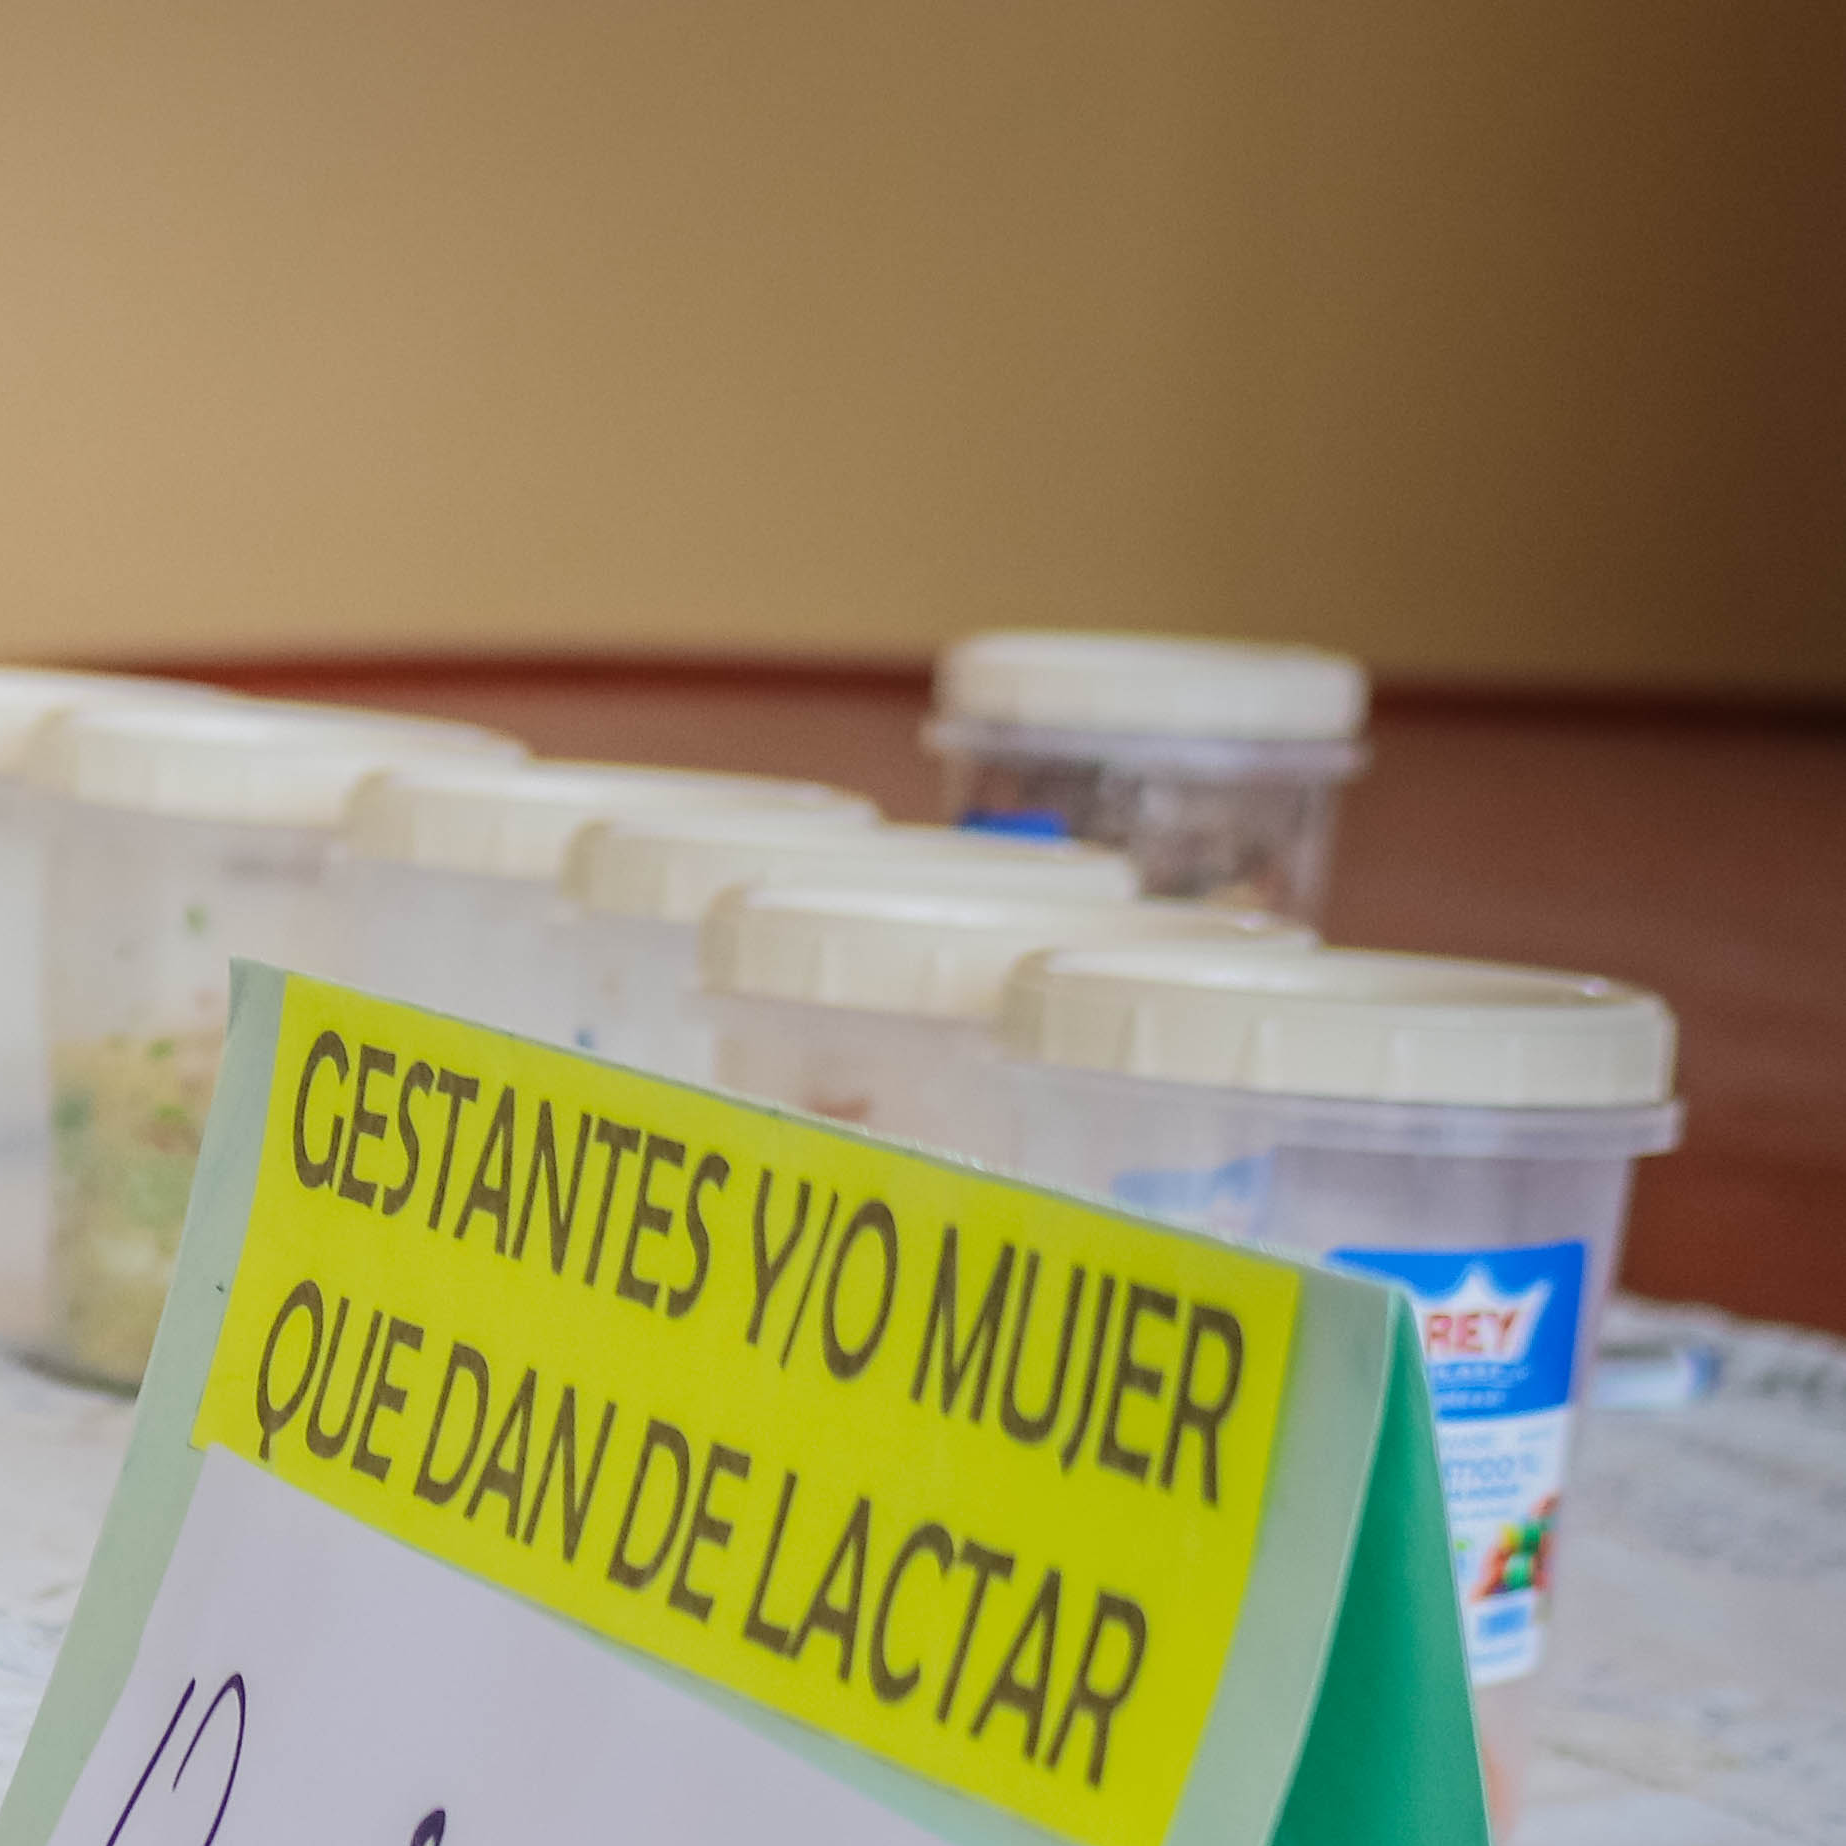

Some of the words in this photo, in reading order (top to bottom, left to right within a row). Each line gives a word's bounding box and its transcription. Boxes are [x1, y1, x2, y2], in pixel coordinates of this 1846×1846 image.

[292, 1028, 731, 1319] GESTANTES
[744, 1166, 899, 1384] Y/O
[909, 1222, 1245, 1510] MUJER
[1424, 1309, 1520, 1354] REY
[256, 1278, 425, 1485] QUE
[413, 1338, 617, 1567] DAN
[606, 1415, 752, 1624] DE
[741, 1467, 1149, 1791] LACTAR
